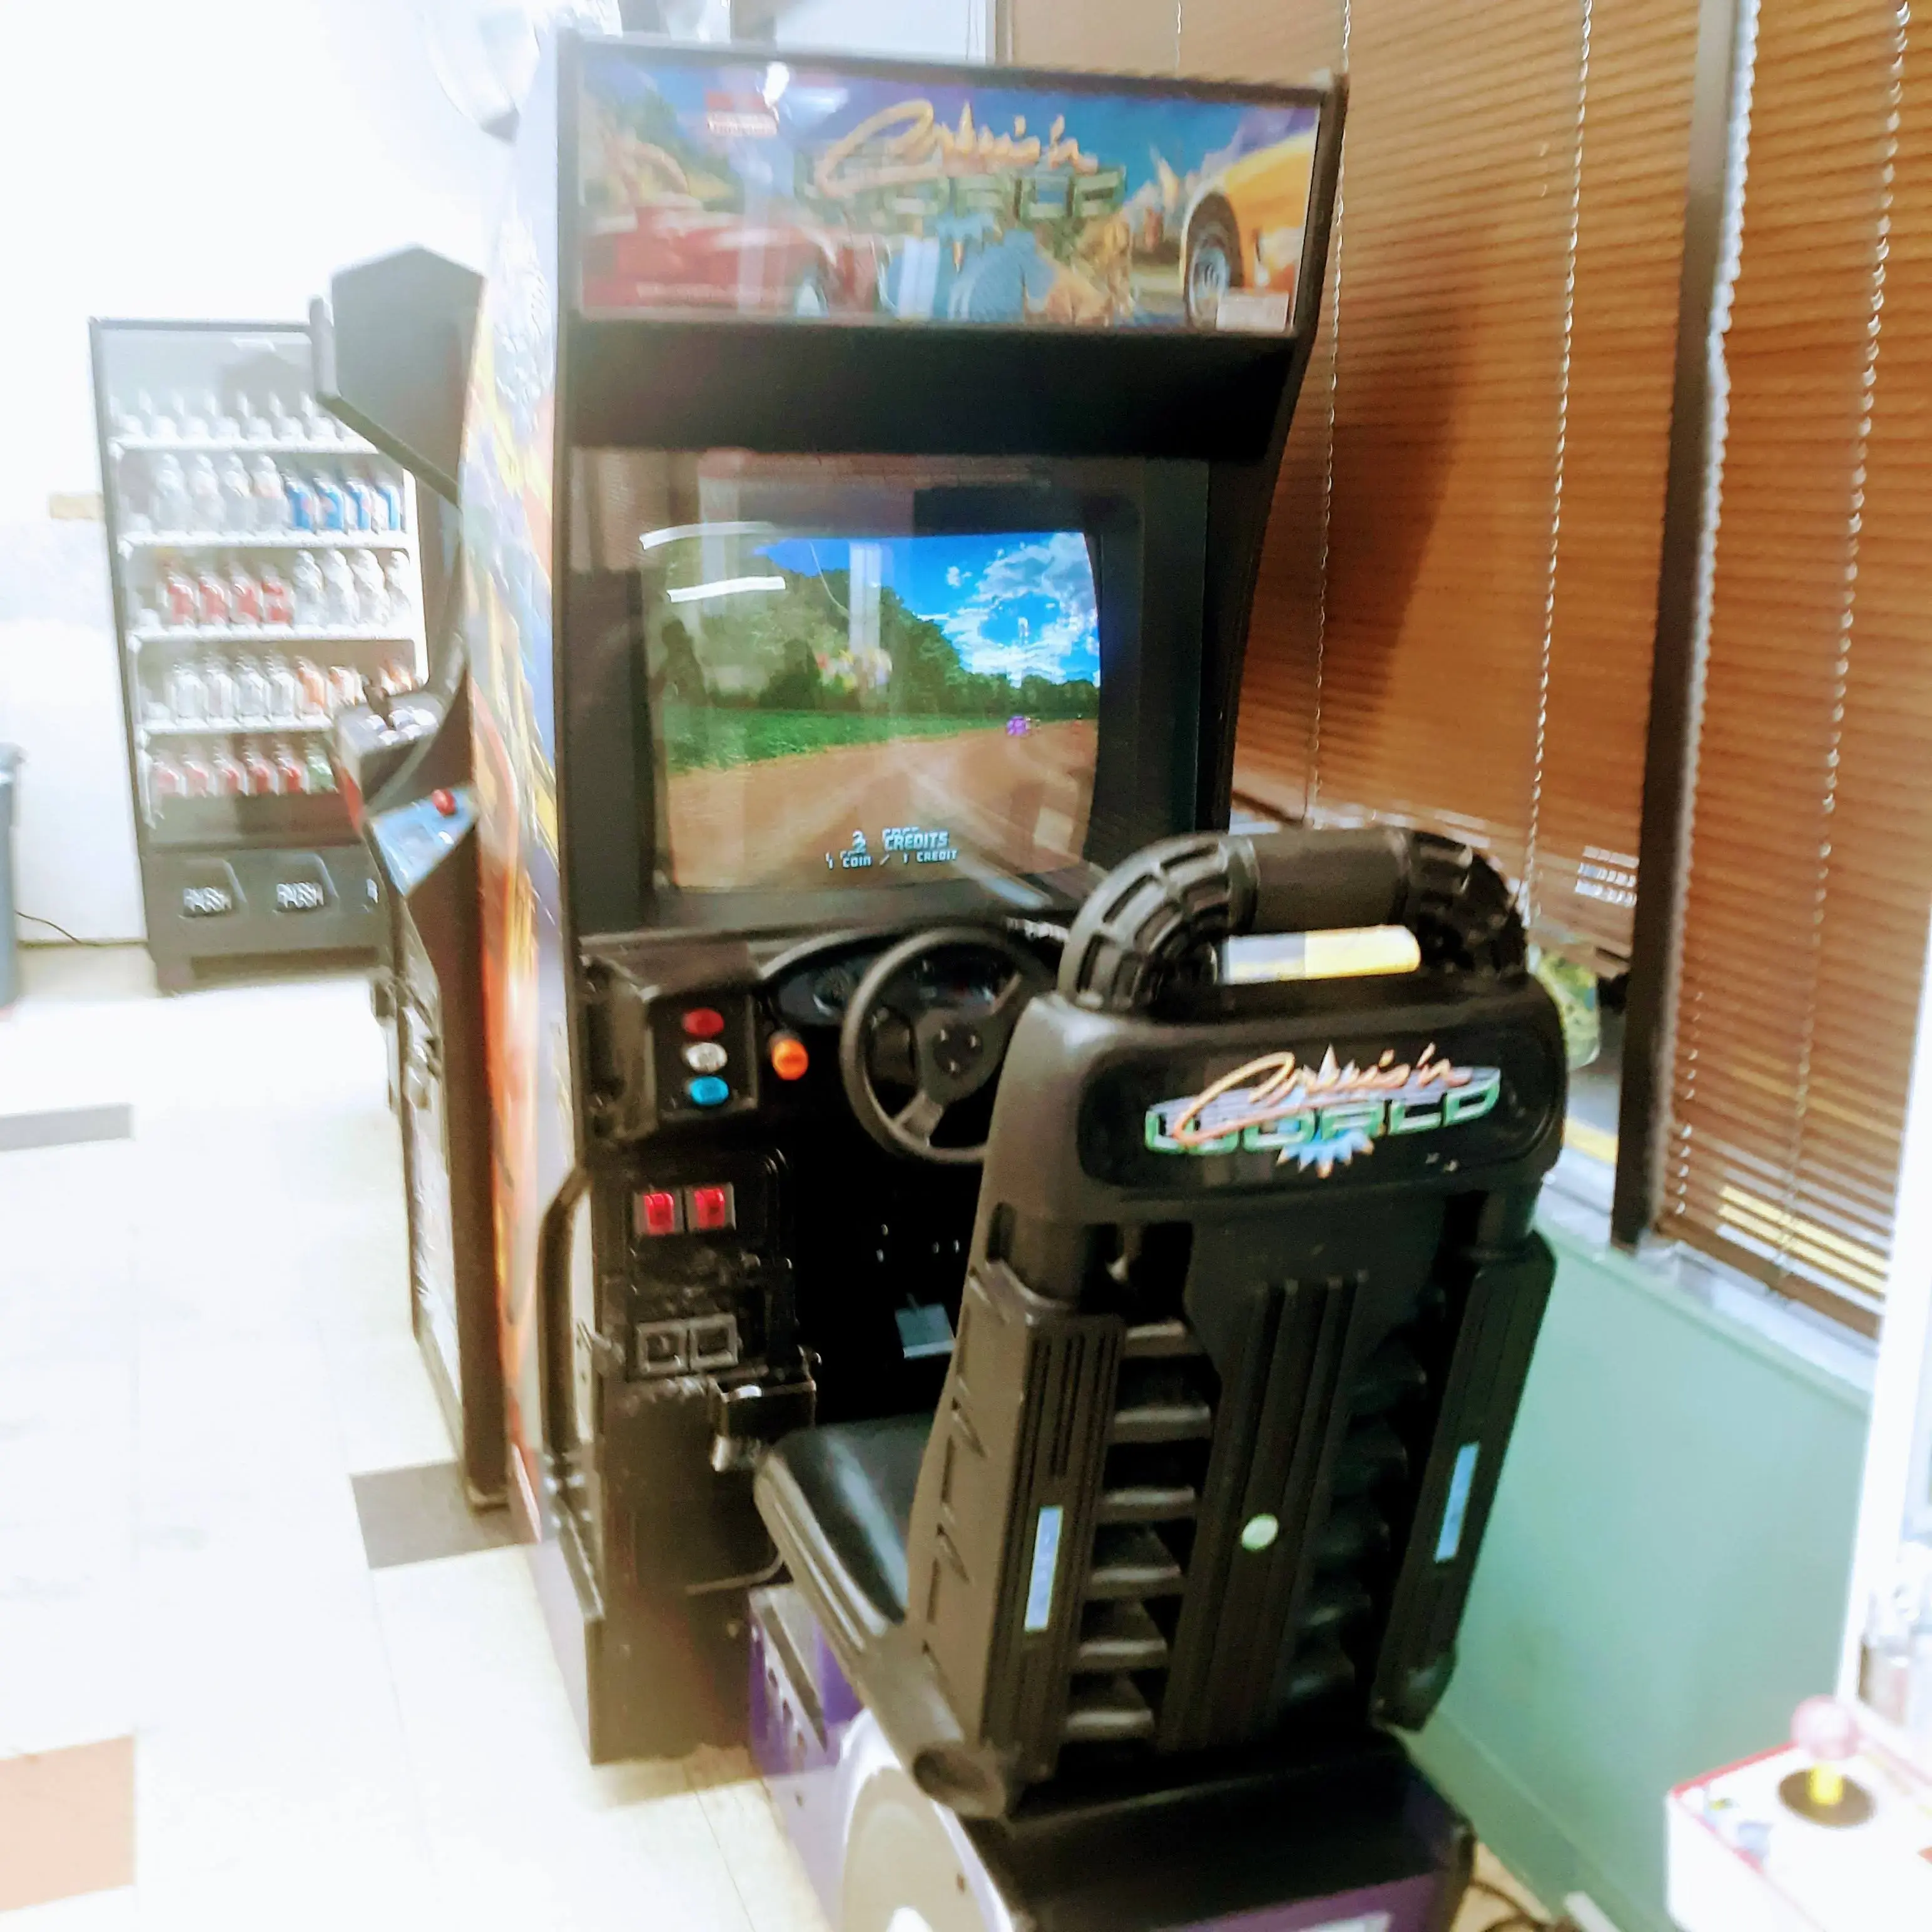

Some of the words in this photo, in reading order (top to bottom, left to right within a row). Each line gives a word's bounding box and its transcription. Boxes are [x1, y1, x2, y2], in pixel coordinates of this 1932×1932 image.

[852, 831, 867, 854] 2
[883, 830, 948, 851] CREDITS
[841, 853, 872, 868] COIN
[916, 850, 957, 863] CREDIT
